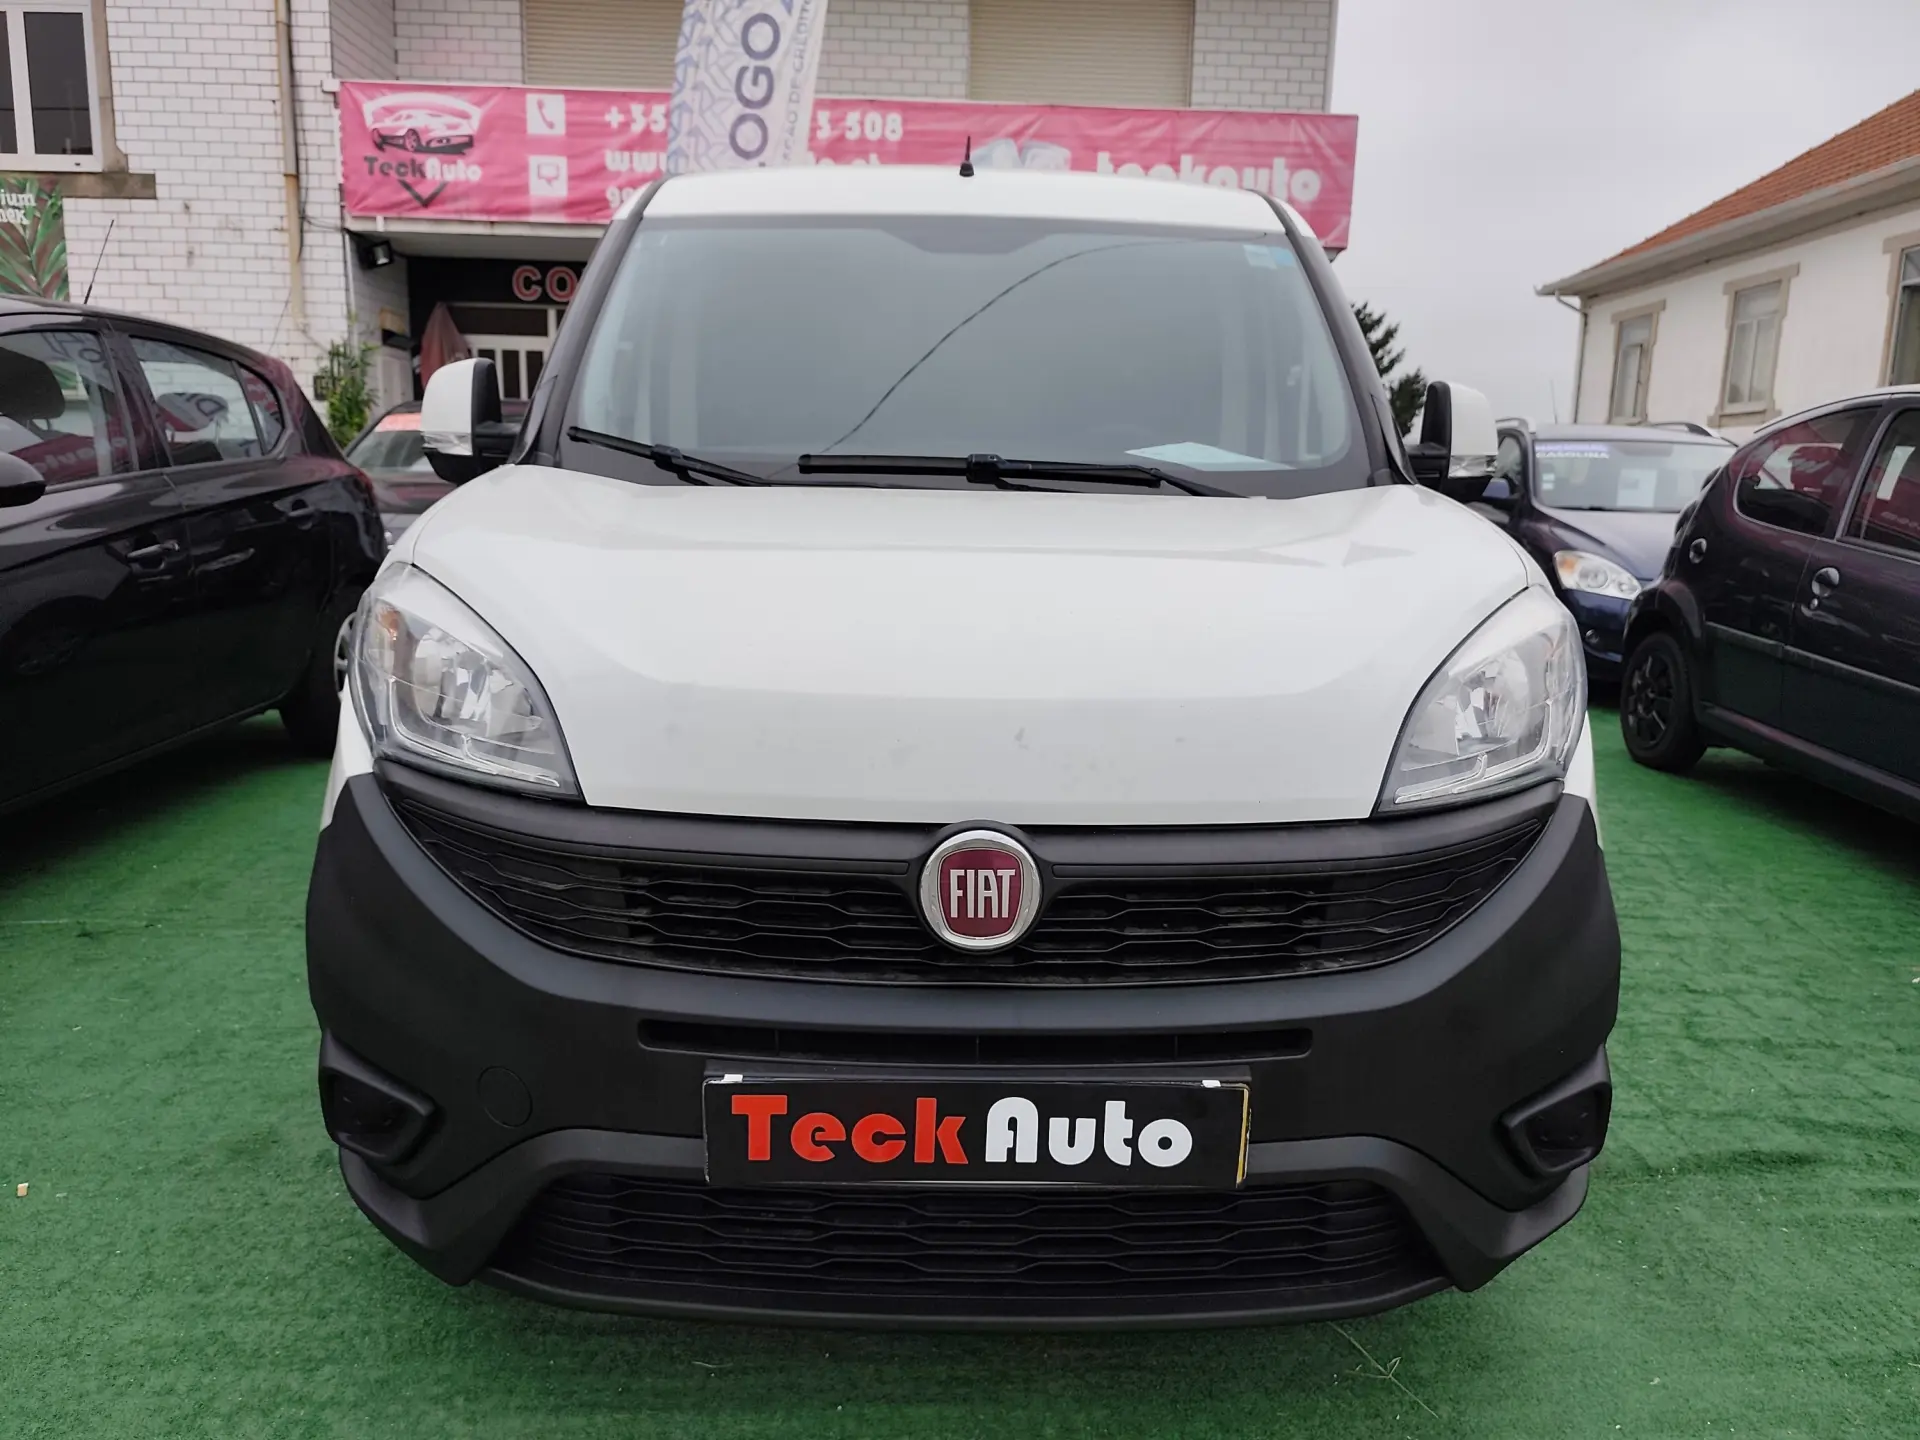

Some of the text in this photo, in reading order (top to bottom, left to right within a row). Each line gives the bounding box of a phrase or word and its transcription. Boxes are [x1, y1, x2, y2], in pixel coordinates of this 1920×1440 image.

[728, 12, 781, 168] OGO
[844, 110, 905, 142] 508
[363, 155, 482, 182] TeckAuto
[511, 265, 578, 302] CO
[949, 868, 1016, 919] FIAT
[731, 1094, 1194, 1168] Teck Auto
